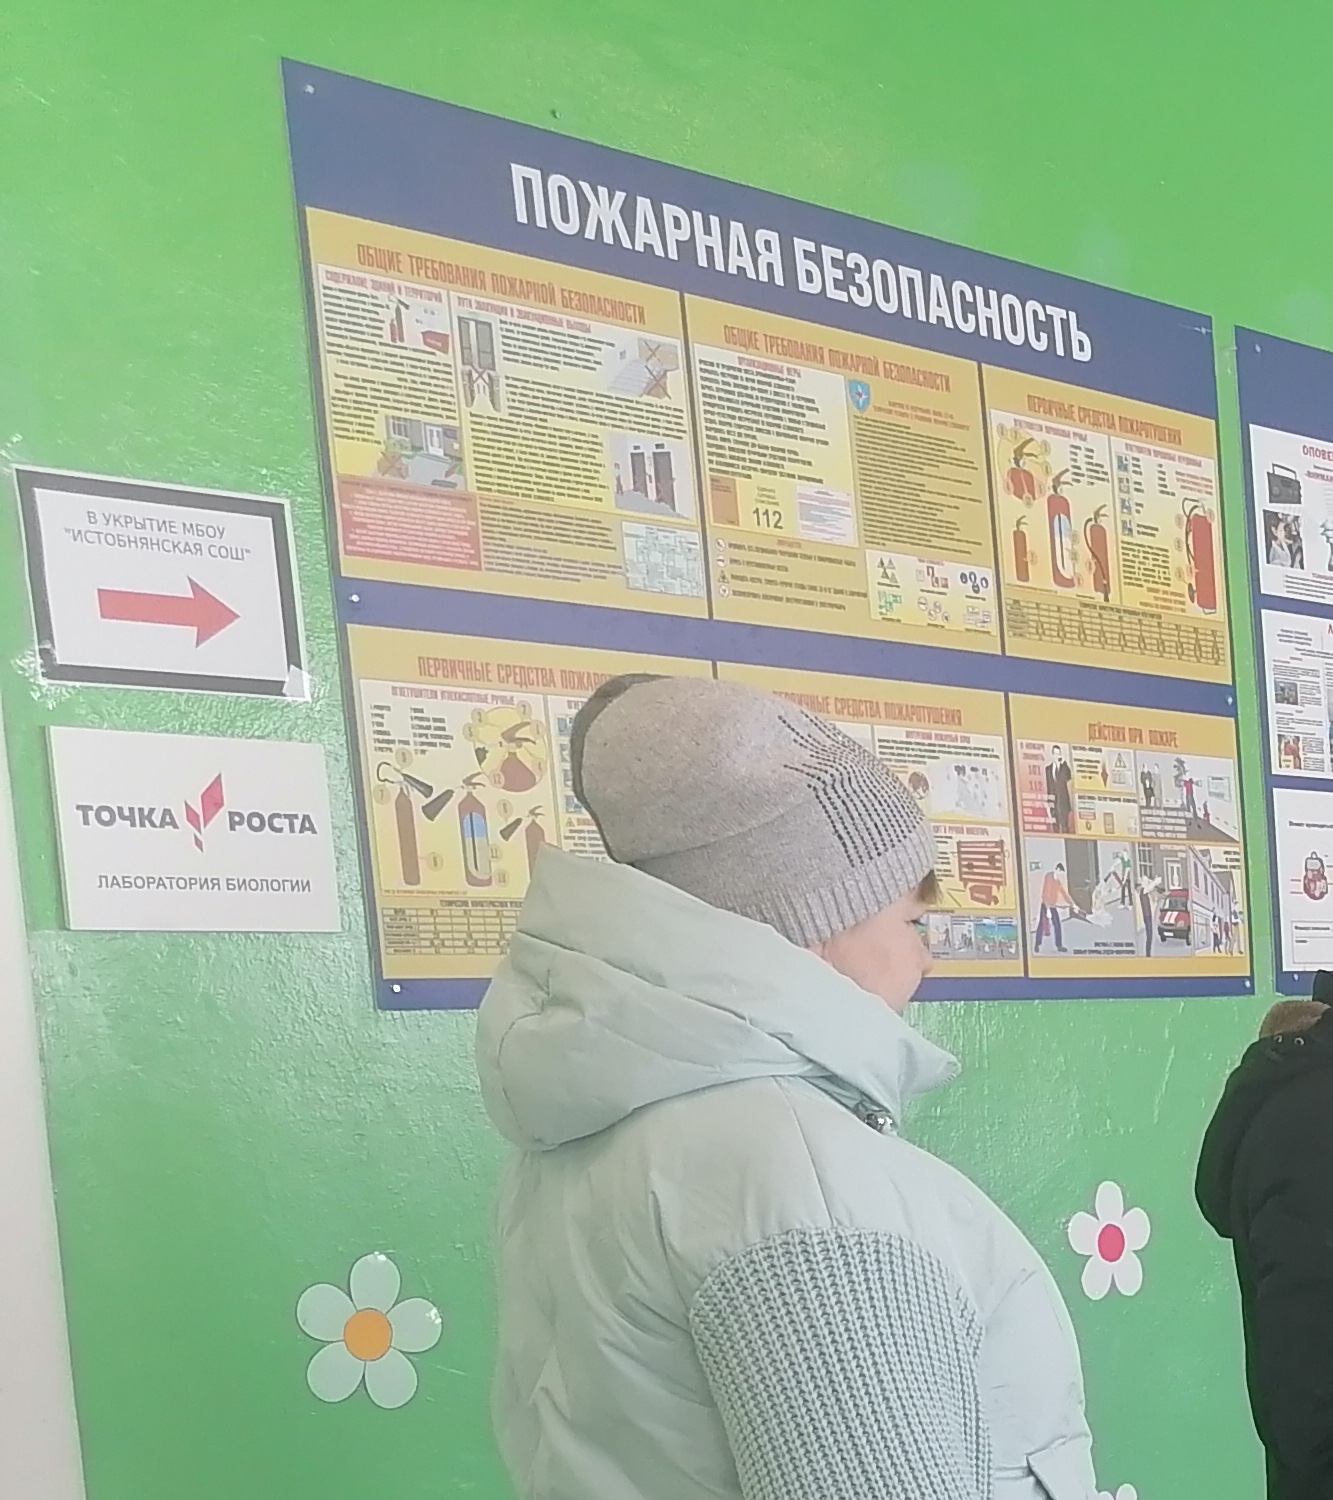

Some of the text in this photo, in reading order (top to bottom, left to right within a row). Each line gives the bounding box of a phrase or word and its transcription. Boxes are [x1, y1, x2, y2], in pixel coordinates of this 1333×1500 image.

[510, 162, 1093, 363] ПОЖАРНАЯ БЕЗОПАСНОСТЬ
[357, 244, 646, 325] ОБЩИЕ ТРЕБОВАНИЯ ПОЖАРНОЙ БЕЗОПАСНОСТИ
[724, 324, 951, 392] ОБЩИЕ ТРЕБОВАНИЯ ПОЖАРНОЙ БЕЗОПАСНОСТИ
[1027, 394, 1075, 422] ПЕРВИЧНЫЕ
[1078, 407, 1115, 431] СРЕДСТВА
[86, 511, 225, 539] В УКРЫТИЕ МБОУ
[752, 507, 784, 530] 112
[64, 526, 251, 562] "ИСТОБНЯНСКАЯ СОШ"
[417, 656, 492, 683] ПЕРВИЧНЫЕ
[497, 663, 556, 688] СРЕДСТВА
[835, 697, 880, 718] СРЕДСТВА
[884, 702, 962, 726] ПОЖАРОТУШЕНИЯ
[1088, 720, 1179, 748] ДЕЙСТВИЯ ПРИ ПОЖАРЕ
[76, 804, 318, 835] ТОЧКА РОСТА
[98, 874, 311, 893] ЛАБОРАТОРИЯ БИОЛОГИИ
